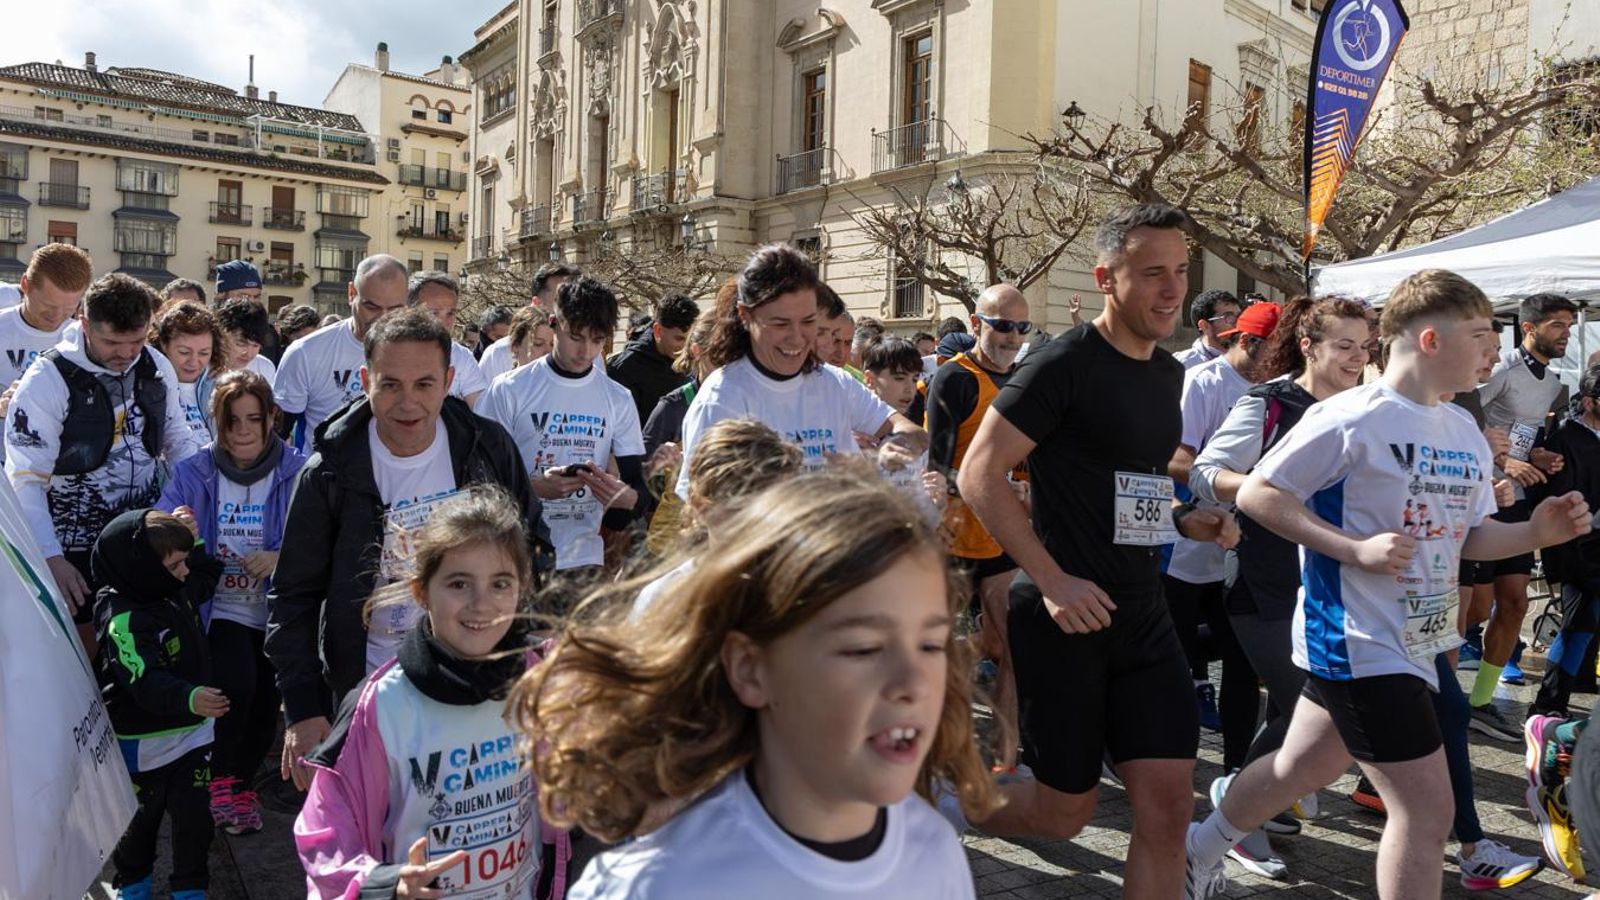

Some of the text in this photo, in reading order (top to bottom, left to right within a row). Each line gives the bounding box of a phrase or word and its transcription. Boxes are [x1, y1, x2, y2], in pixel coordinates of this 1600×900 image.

[531, 412, 606, 433] V CARRERA
[549, 424, 604, 438] CAMINATA
[1389, 443, 1414, 474] V
[1419, 461, 1484, 482] CAMINATA
[1119, 476, 1131, 491] V
[1448, 485, 1474, 496] MUERT
[218, 513, 263, 525] CAMIN
[224, 503, 265, 514] CARR
[1134, 500, 1161, 522] 586
[247, 529, 264, 537] MUE
[1409, 599, 1421, 614] V
[1419, 611, 1448, 635] 465
[409, 734, 517, 798] V CARR
[443, 757, 519, 793] CAMIN
[455, 791, 493, 816] BUENA
[496, 775, 530, 804] MUERT
[432, 825, 451, 848] V
[456, 812, 513, 834] CARRERA
[451, 821, 513, 846] CAMINATA
[463, 831, 527, 885] 1046
